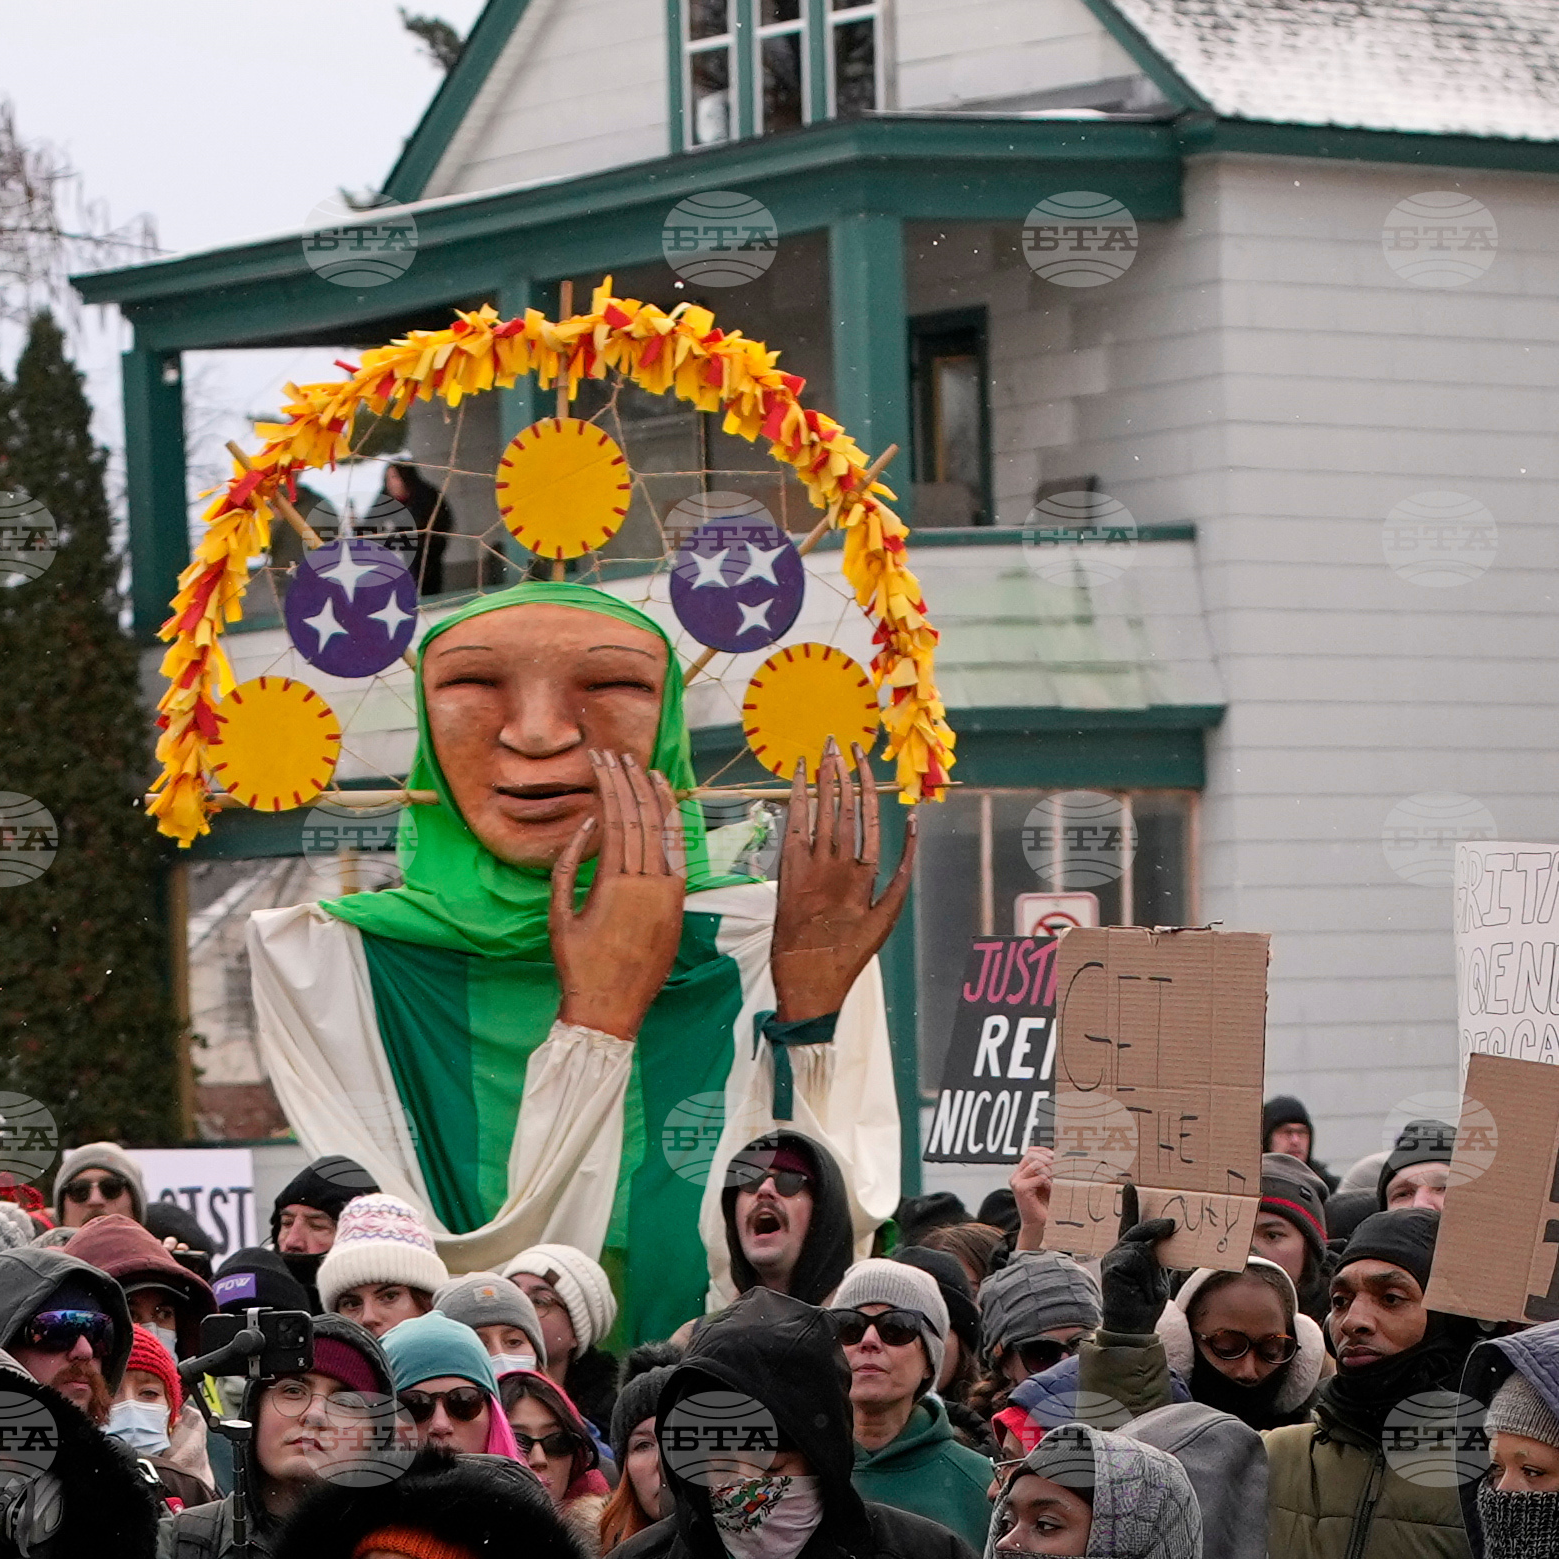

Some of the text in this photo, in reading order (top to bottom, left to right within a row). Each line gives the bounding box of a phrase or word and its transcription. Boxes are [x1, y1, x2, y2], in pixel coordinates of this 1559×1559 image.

[1060, 961, 1173, 1092] GET
[928, 1089, 1050, 1156] NICOLE
[1125, 1105, 1199, 1185] THE
